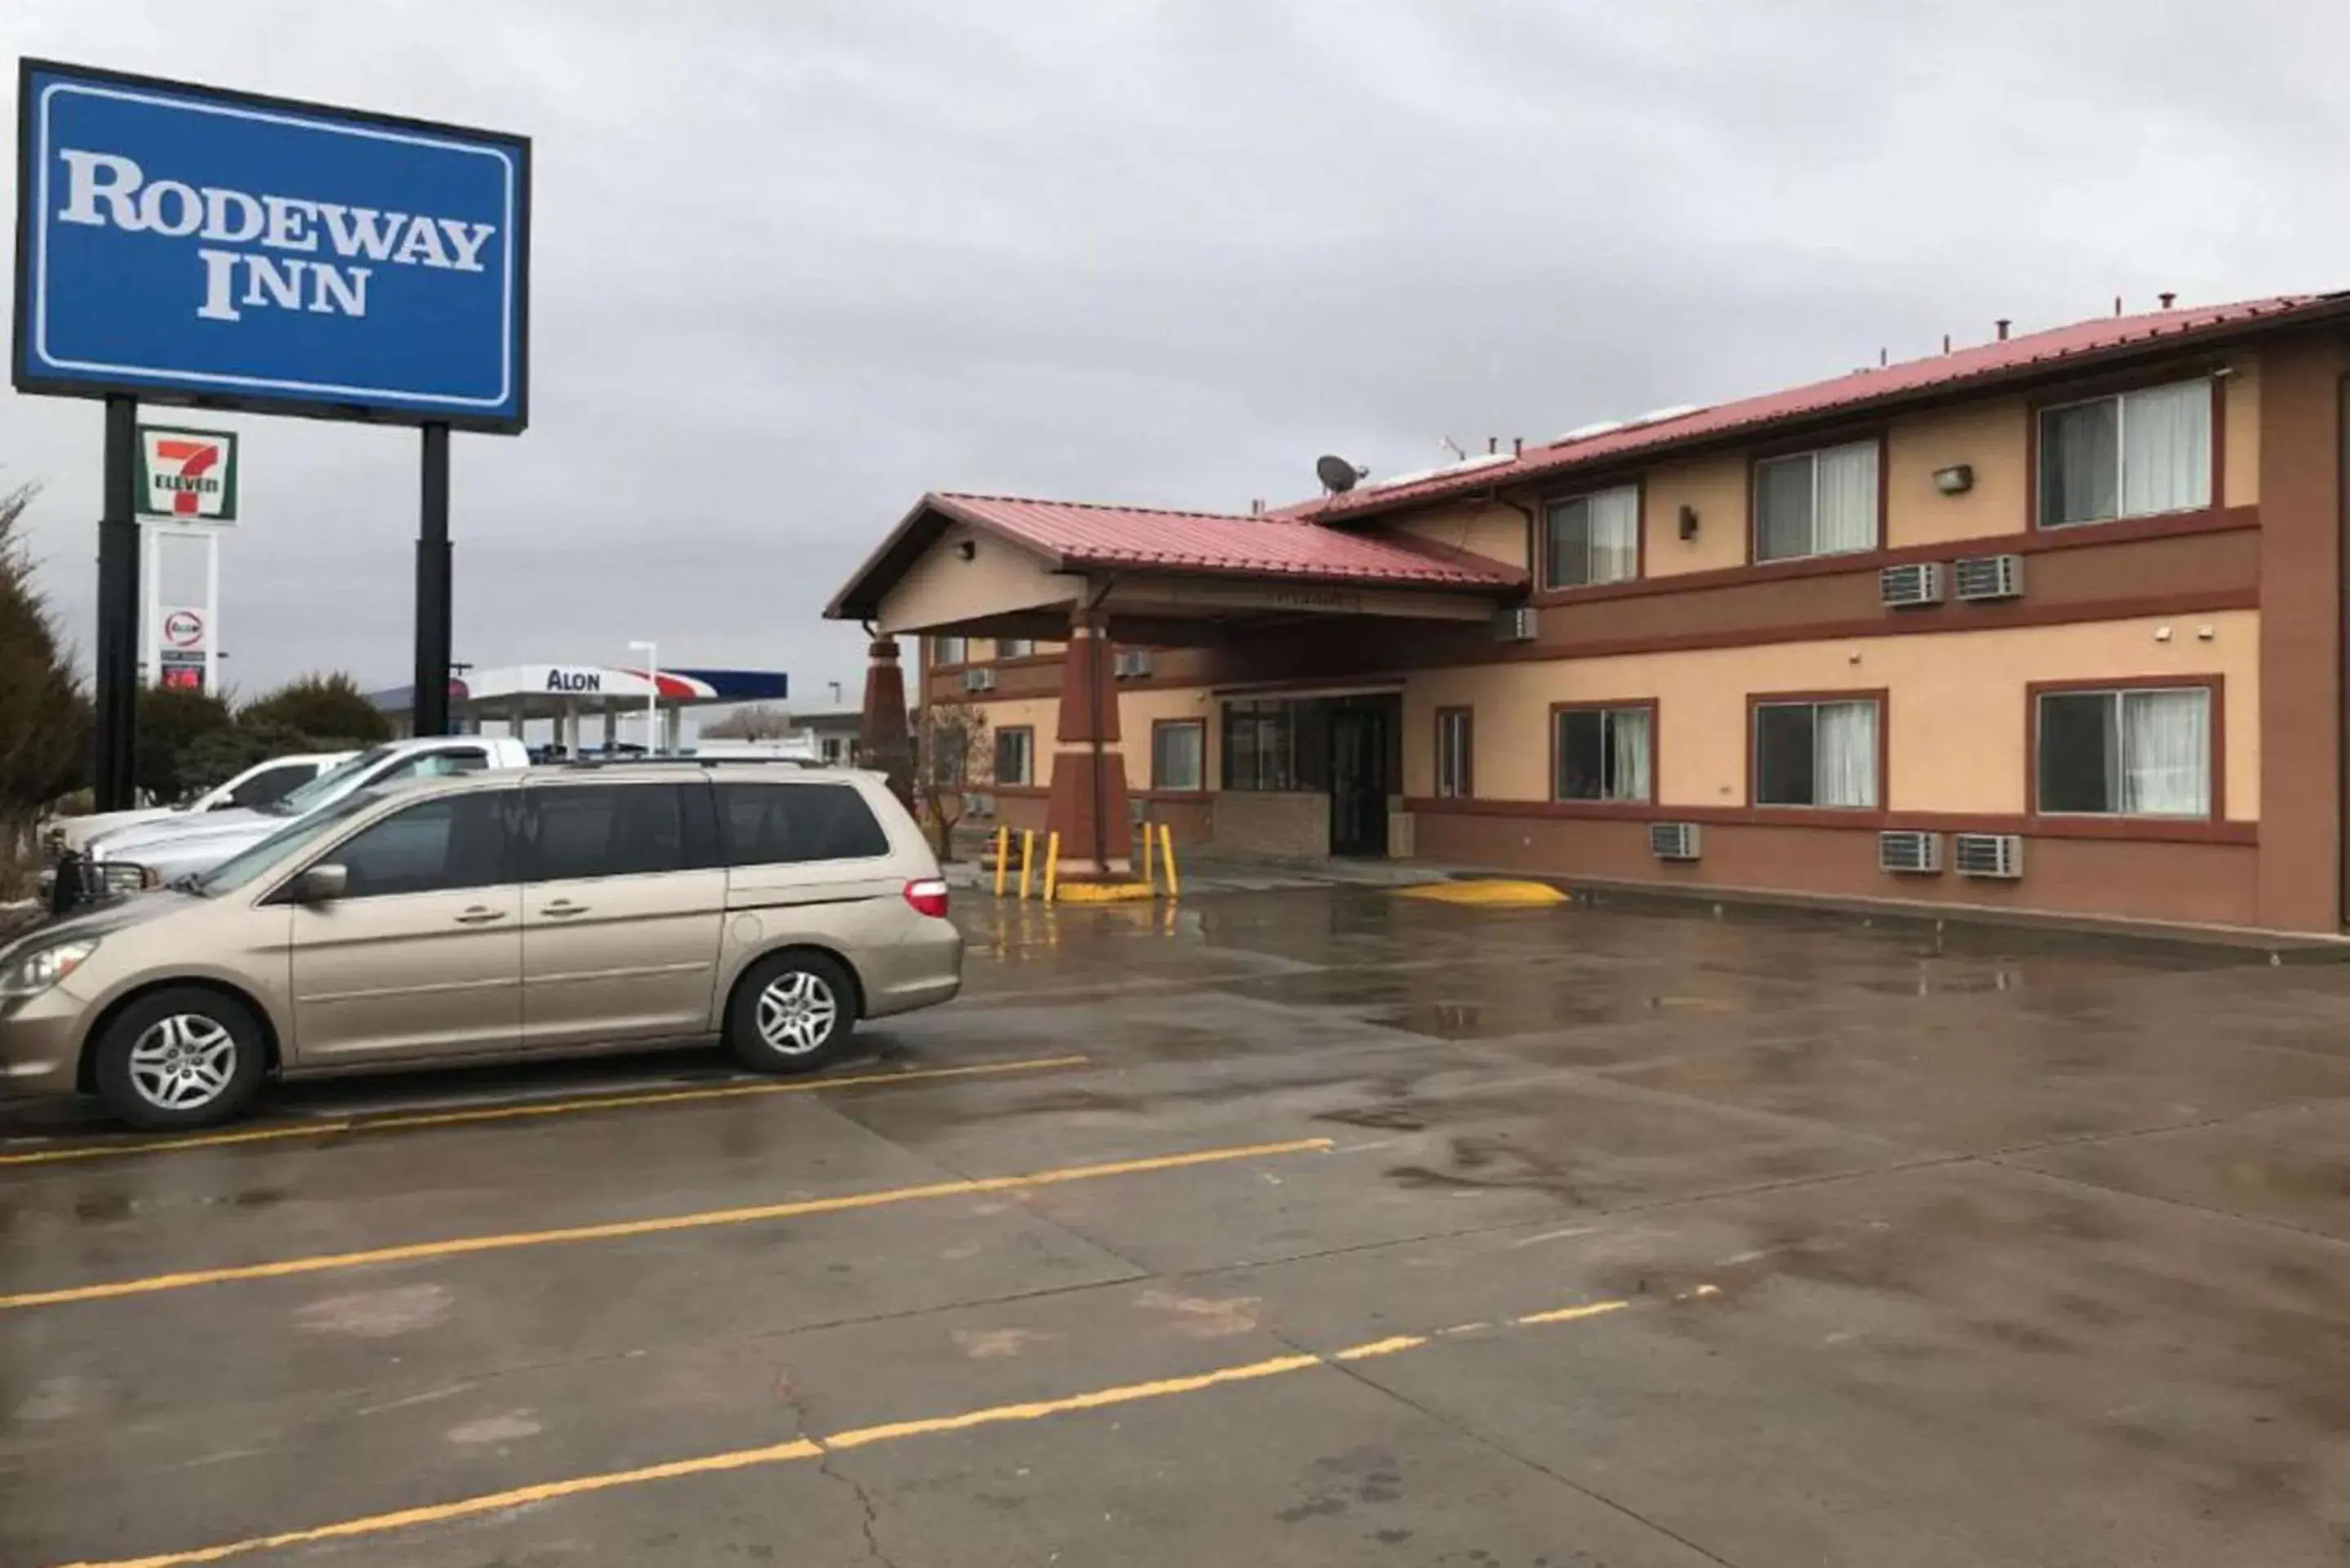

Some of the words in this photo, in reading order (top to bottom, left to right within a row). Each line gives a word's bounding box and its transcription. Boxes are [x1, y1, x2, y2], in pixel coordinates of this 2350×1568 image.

[59, 149, 495, 272] RODEWAY
[198, 248, 372, 322] INN
[157, 441, 219, 515] 7
[547, 669, 601, 691] ALON
